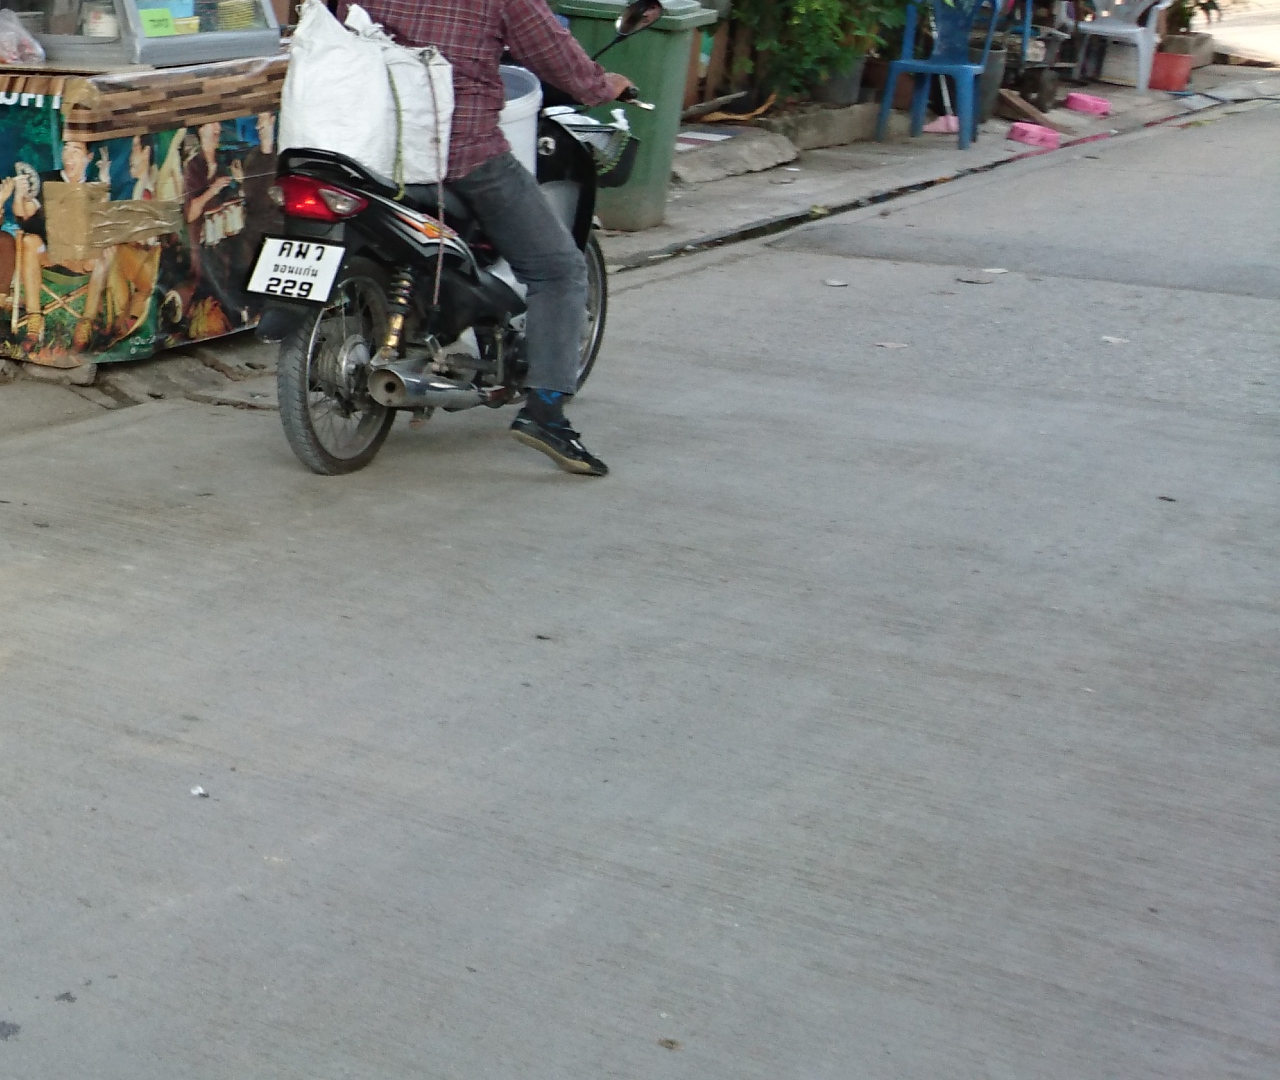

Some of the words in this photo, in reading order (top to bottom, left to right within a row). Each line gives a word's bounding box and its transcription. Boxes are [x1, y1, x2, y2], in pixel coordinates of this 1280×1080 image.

[272, 263, 319, 278] ขอนแก่น
[265, 277, 314, 298] 229
